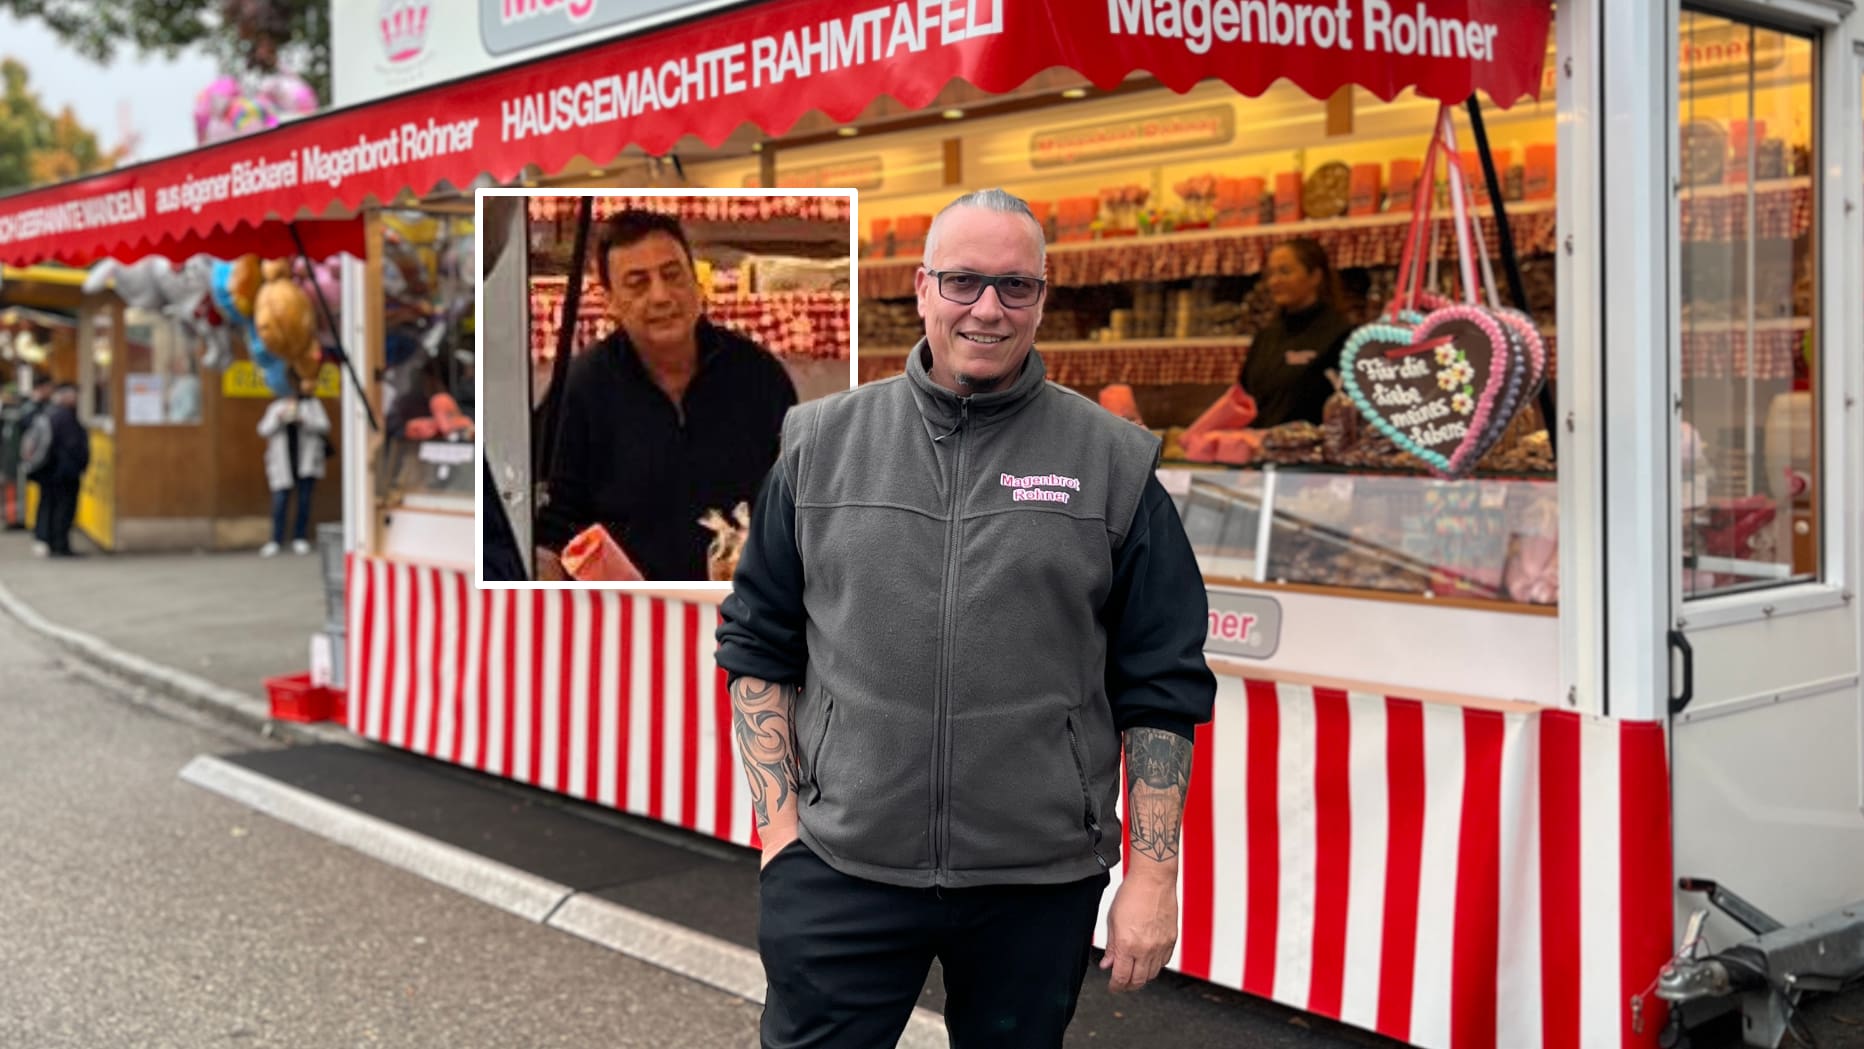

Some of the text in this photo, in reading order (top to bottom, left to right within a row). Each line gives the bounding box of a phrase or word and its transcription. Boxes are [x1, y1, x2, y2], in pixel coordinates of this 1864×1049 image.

[1106, 0, 1498, 62] Magenbrot Rohner
[501, 43, 747, 142] HAUSGEMACHTE
[301, 118, 479, 187] Magenbrot Rohner
[155, 151, 298, 214] aus eigener Bäckerei
[1400, 355, 1431, 378] die
[1389, 398, 1451, 428] meines
[1000, 473, 1080, 491] Magenbrot
[1013, 488, 1070, 504] Rohner
